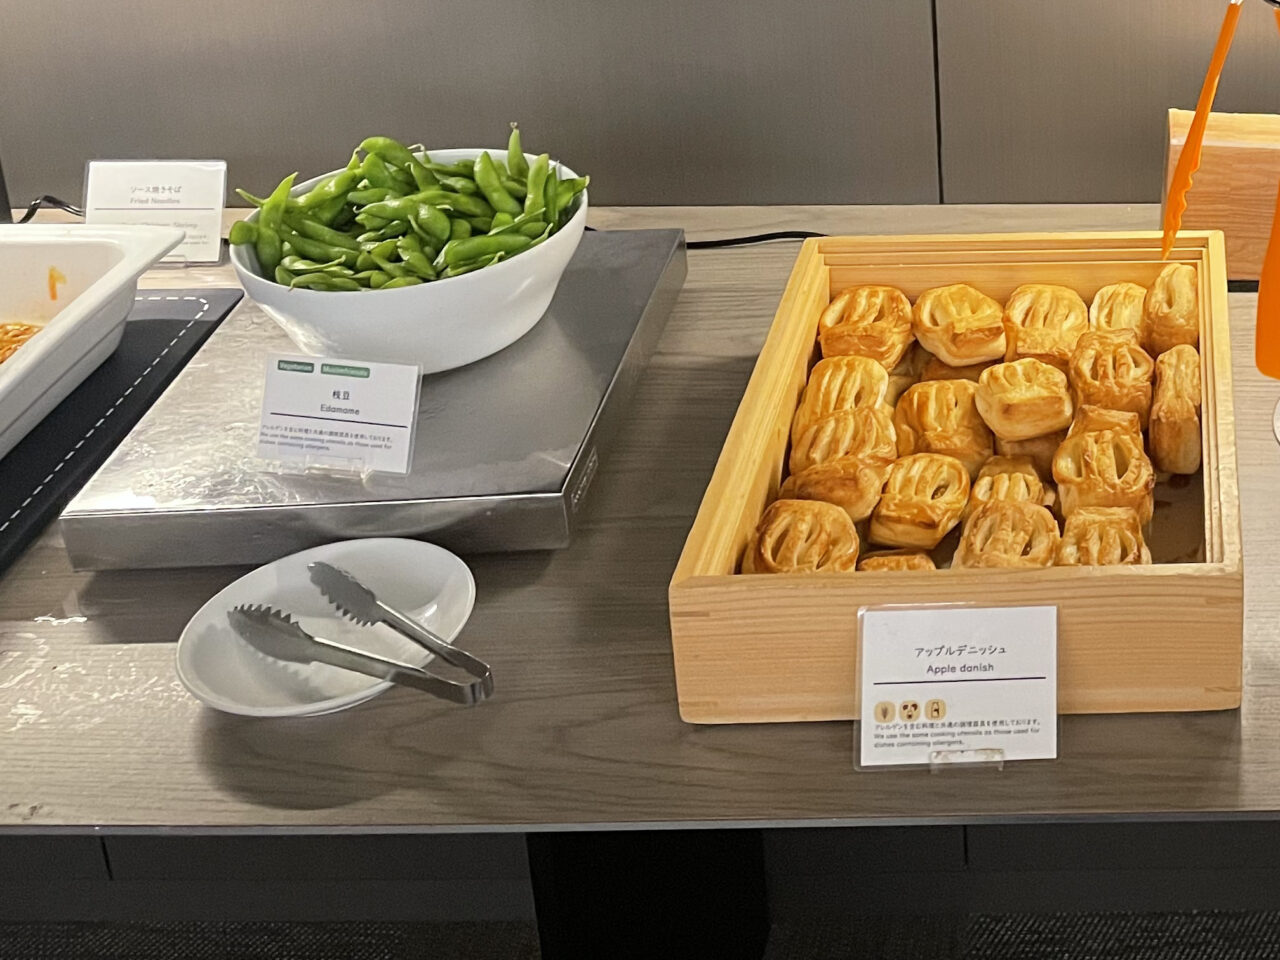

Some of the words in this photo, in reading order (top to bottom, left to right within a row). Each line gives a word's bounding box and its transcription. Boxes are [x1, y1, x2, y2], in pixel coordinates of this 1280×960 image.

[332, 390, 351, 400] 枝豆
[320, 403, 360, 415] Edamame
[915, 644, 1007, 658] アップルデニッシュ
[926, 664, 956, 675] Apple
[960, 664, 994, 673] danish
